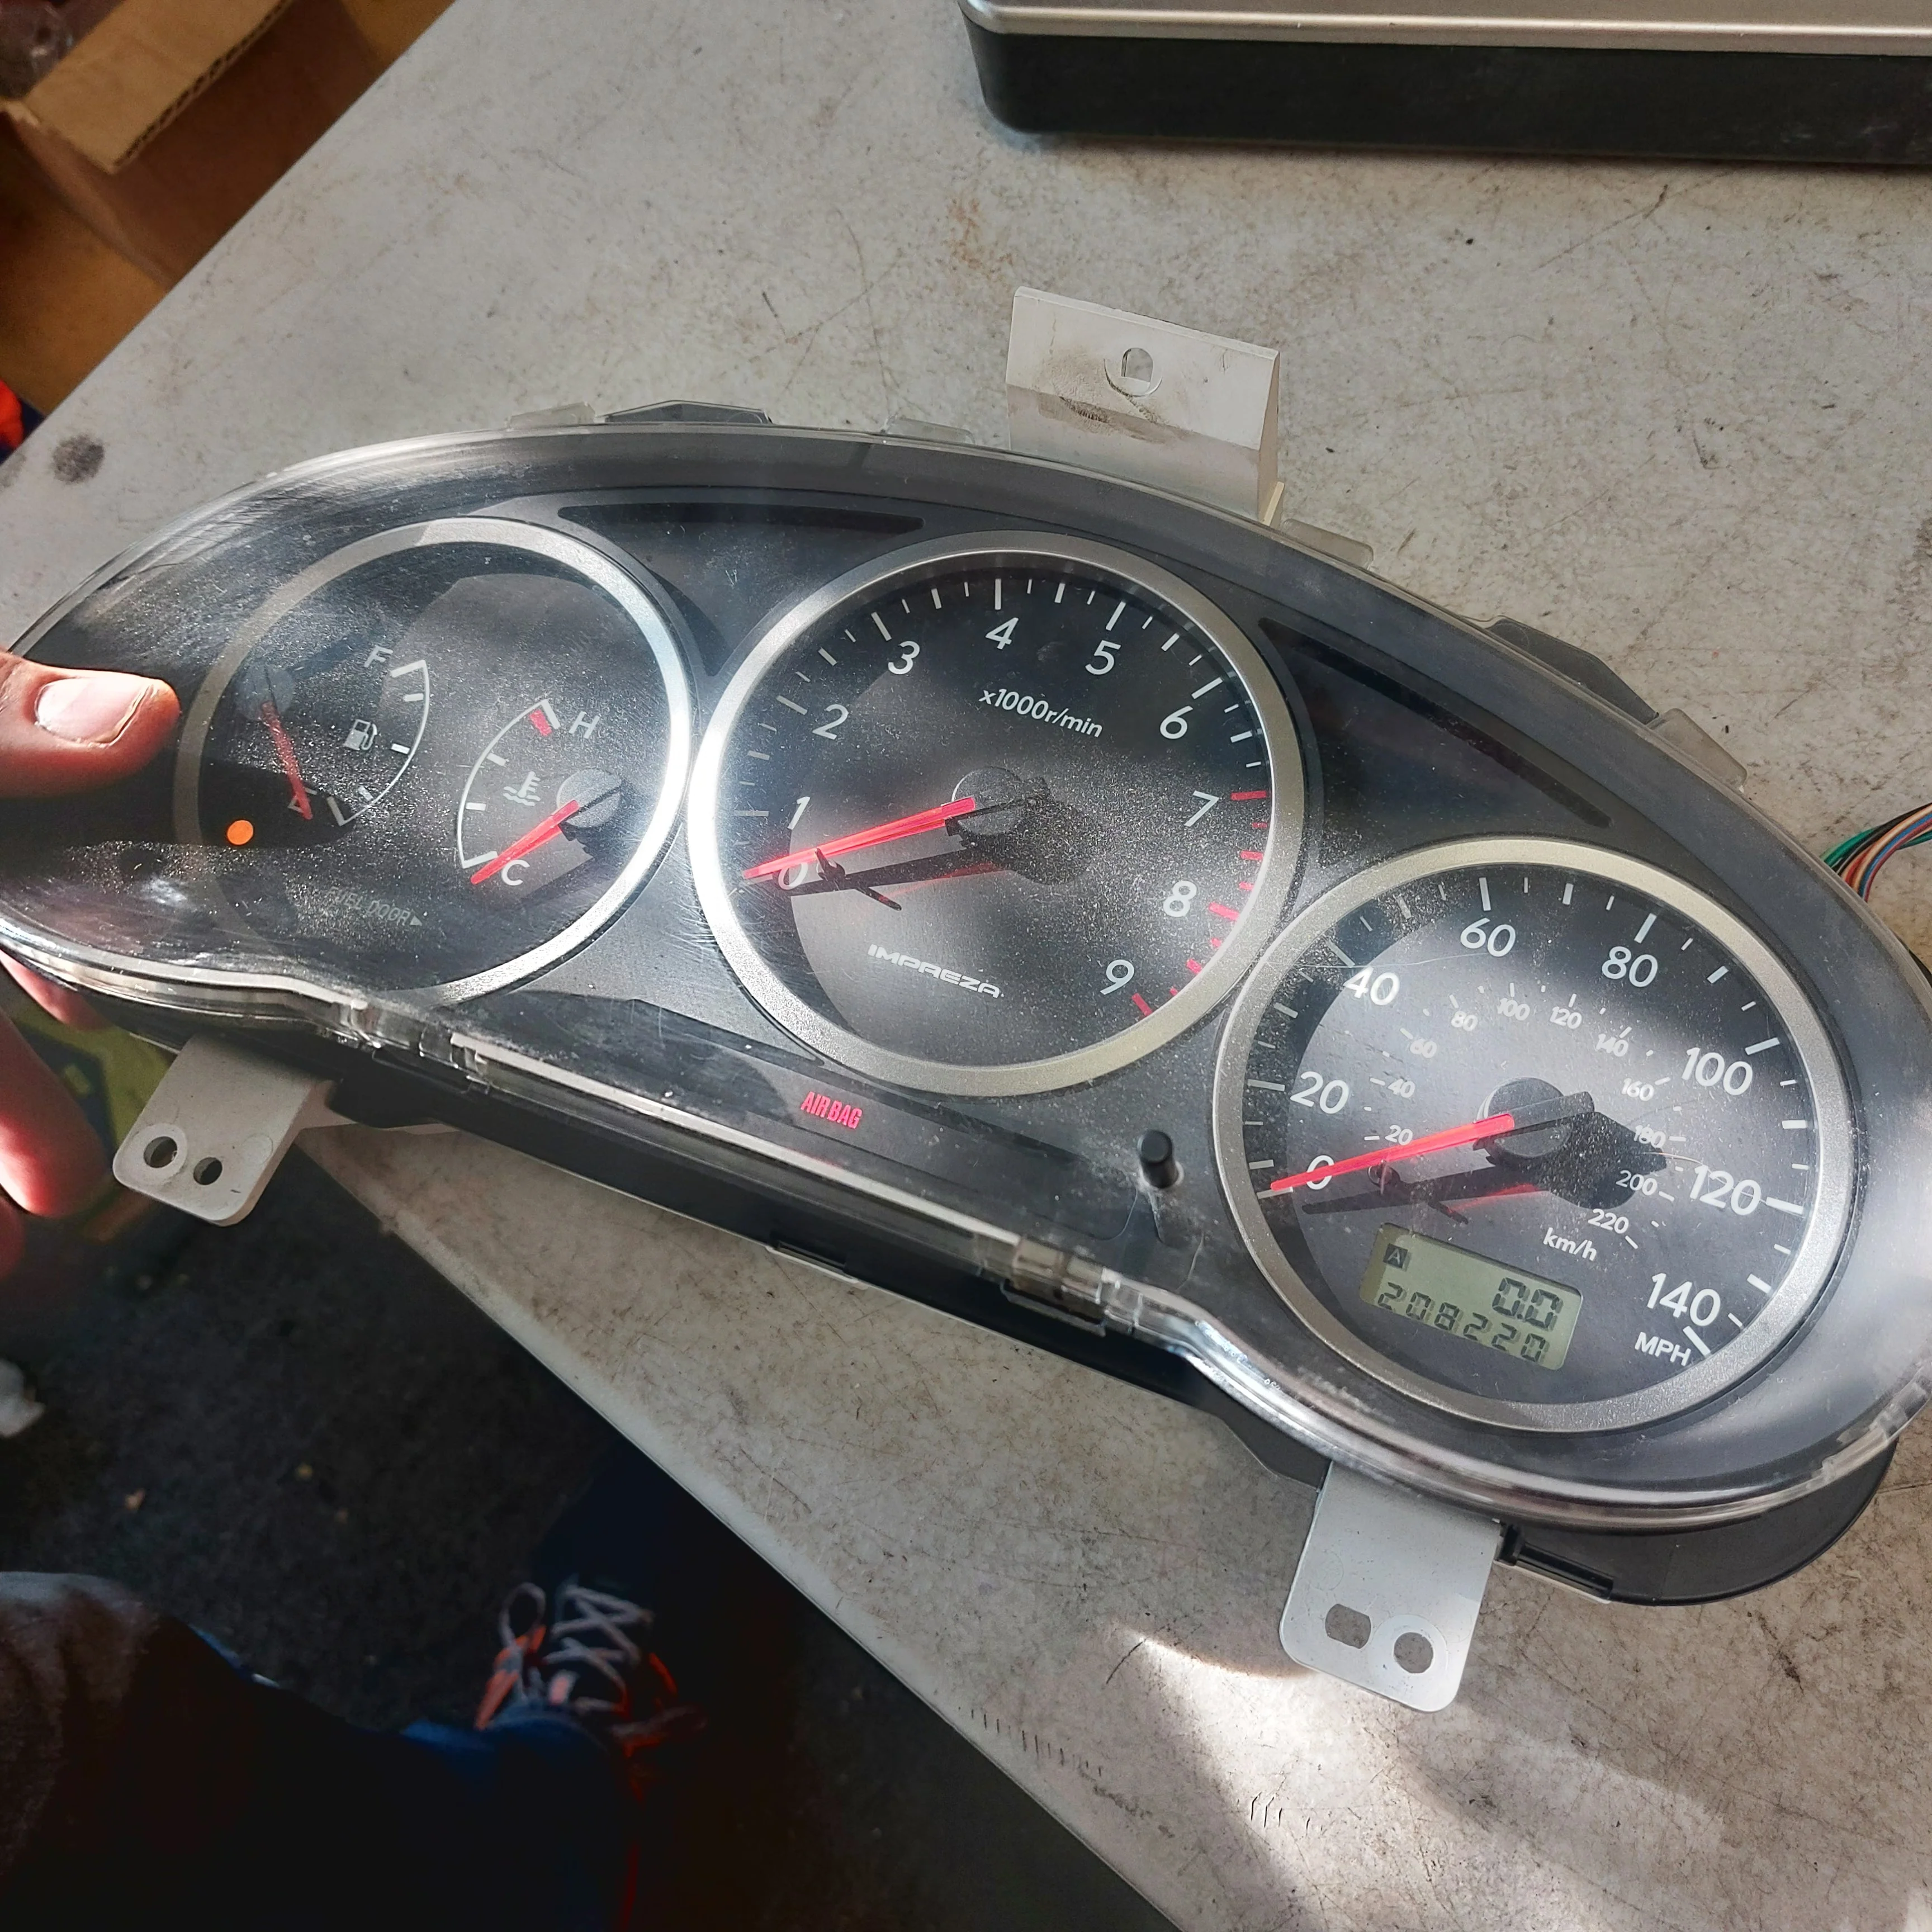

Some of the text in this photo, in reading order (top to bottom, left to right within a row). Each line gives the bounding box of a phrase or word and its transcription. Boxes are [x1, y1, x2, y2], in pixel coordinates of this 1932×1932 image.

[985, 617, 1020, 650] 4
[364, 645, 393, 667] F
[887, 640, 921, 675] 3
[1085, 640, 1121, 675] 5
[569, 710, 600, 740] H
[812, 704, 849, 740] 2
[978, 688, 1103, 737] x1000r/min
[1158, 705, 1194, 740] 6
[787, 796, 810, 830] 1
[1184, 790, 1219, 826] 7
[500, 859, 531, 887] C
[1162, 880, 1197, 917] 8
[1459, 917, 1516, 957] 60
[868, 944, 1002, 998] IMPREZA
[1100, 959, 1135, 995] 9
[1600, 946, 1659, 988] 80
[1342, 965, 1400, 1006] 40
[1451, 1010, 1479, 1031] 80
[1498, 997, 1531, 1021] 100
[1550, 1006, 1583, 1029] 120
[1409, 1038, 1438, 1059] 60
[1596, 1033, 1629, 1057] 140
[1388, 1078, 1416, 1098] 40
[1681, 1047, 1753, 1096] 100
[1290, 1071, 1349, 1114] 20
[1621, 1077, 1655, 1102] 160
[1384, 1124, 1414, 1146] 20
[1306, 1154, 1335, 1191] 0
[1615, 1170, 1658, 1196] 200
[1689, 1165, 1761, 1215] 120
[1588, 1209, 1630, 1235] 220
[1542, 1227, 1598, 1262] km/h
[1646, 1272, 1721, 1326] 140
[1377, 1281, 1547, 1363] 208220
[1633, 1332, 1692, 1367] MPH
